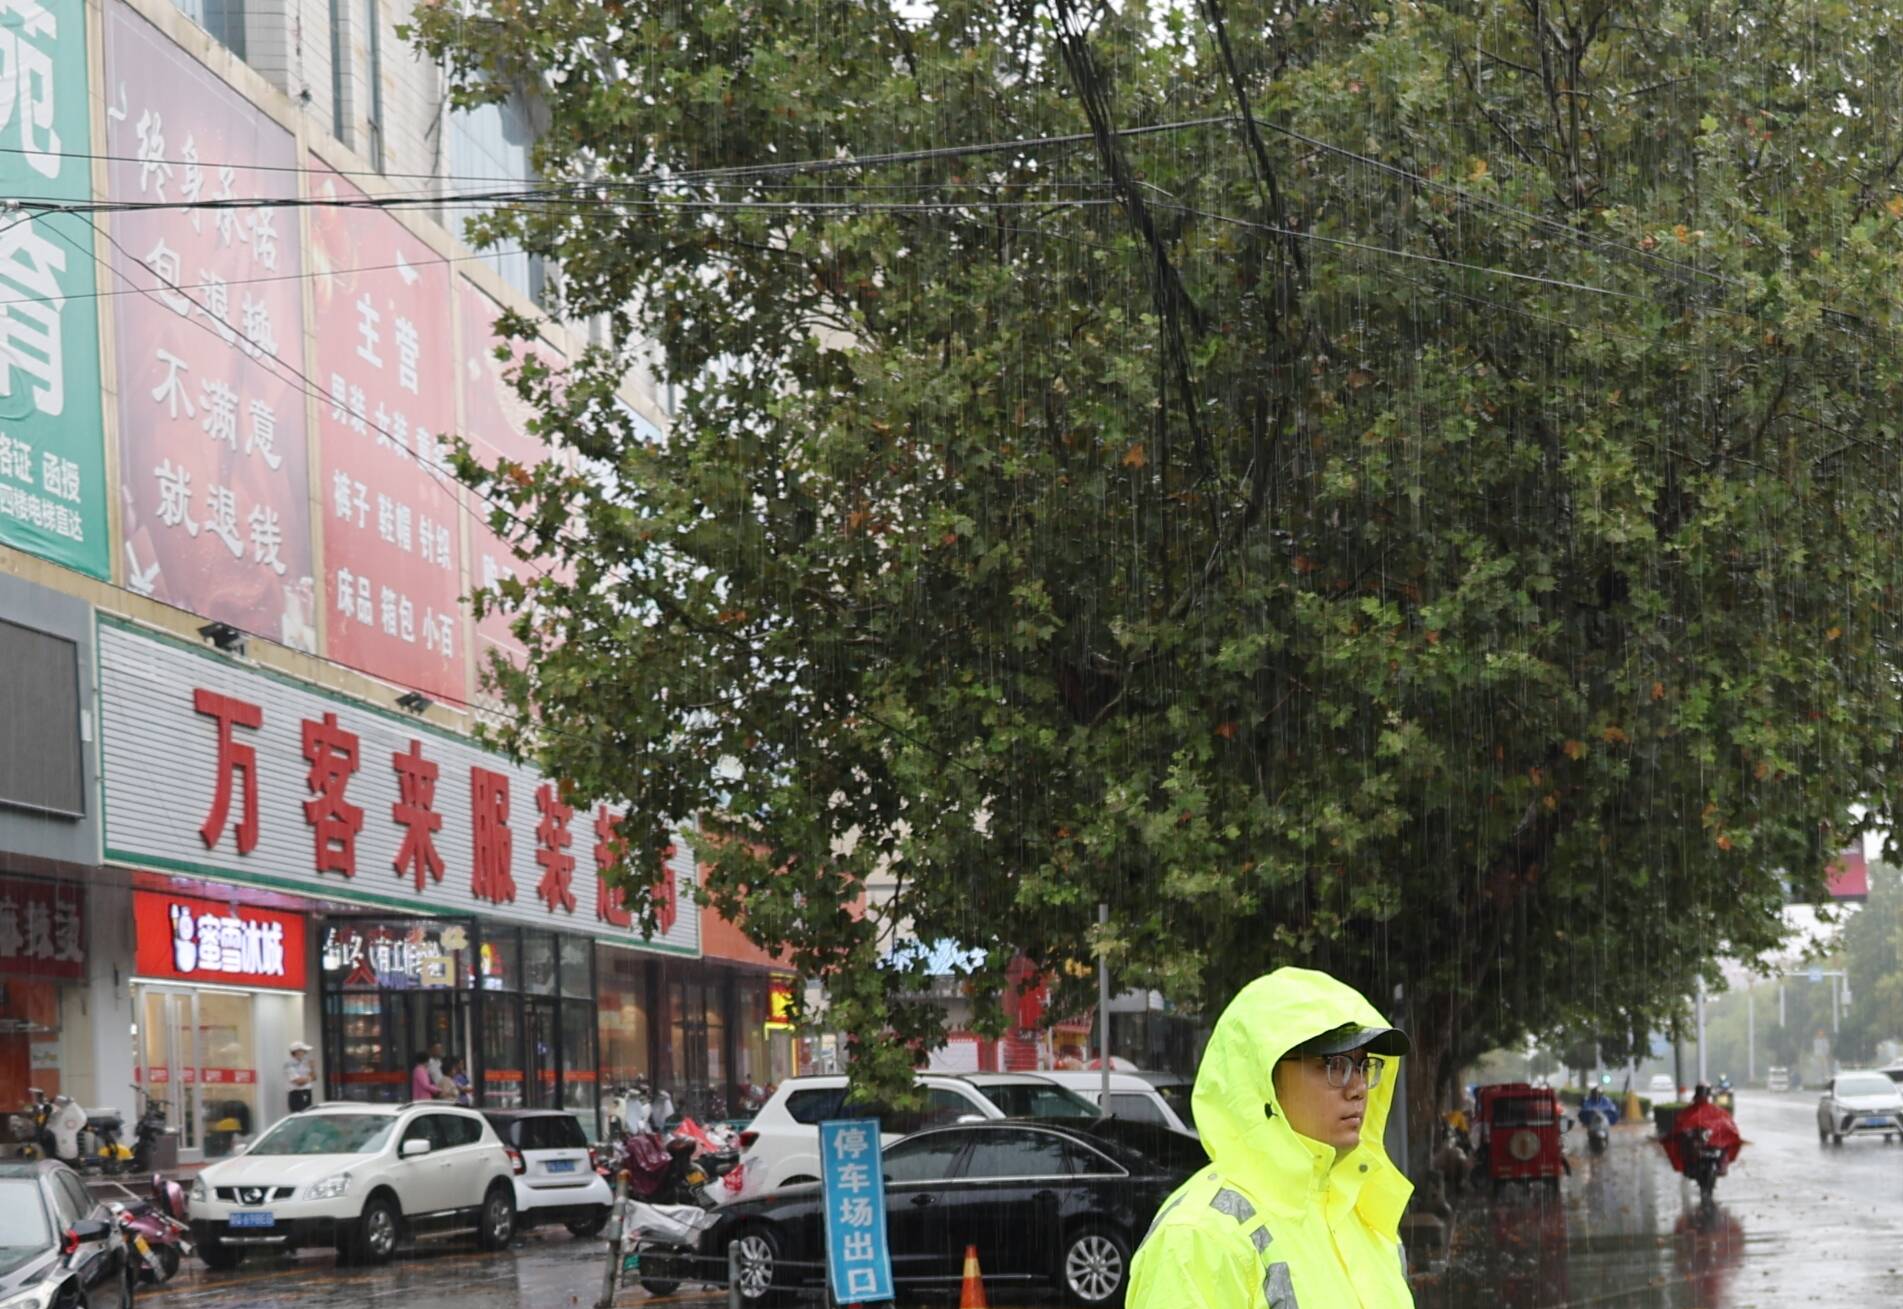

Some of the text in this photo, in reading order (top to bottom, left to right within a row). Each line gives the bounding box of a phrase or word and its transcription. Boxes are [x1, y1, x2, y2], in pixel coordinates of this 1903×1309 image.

[356, 292, 419, 396] 主营
[152, 348, 283, 471] 不满意
[43, 451, 81, 504] 函授
[153, 457, 287, 576] 就退钱
[336, 567, 454, 658] 床品 箱包 小百
[197, 913, 285, 977] 蜜雪冰城
[833, 1128, 878, 1294] 停车场出口
